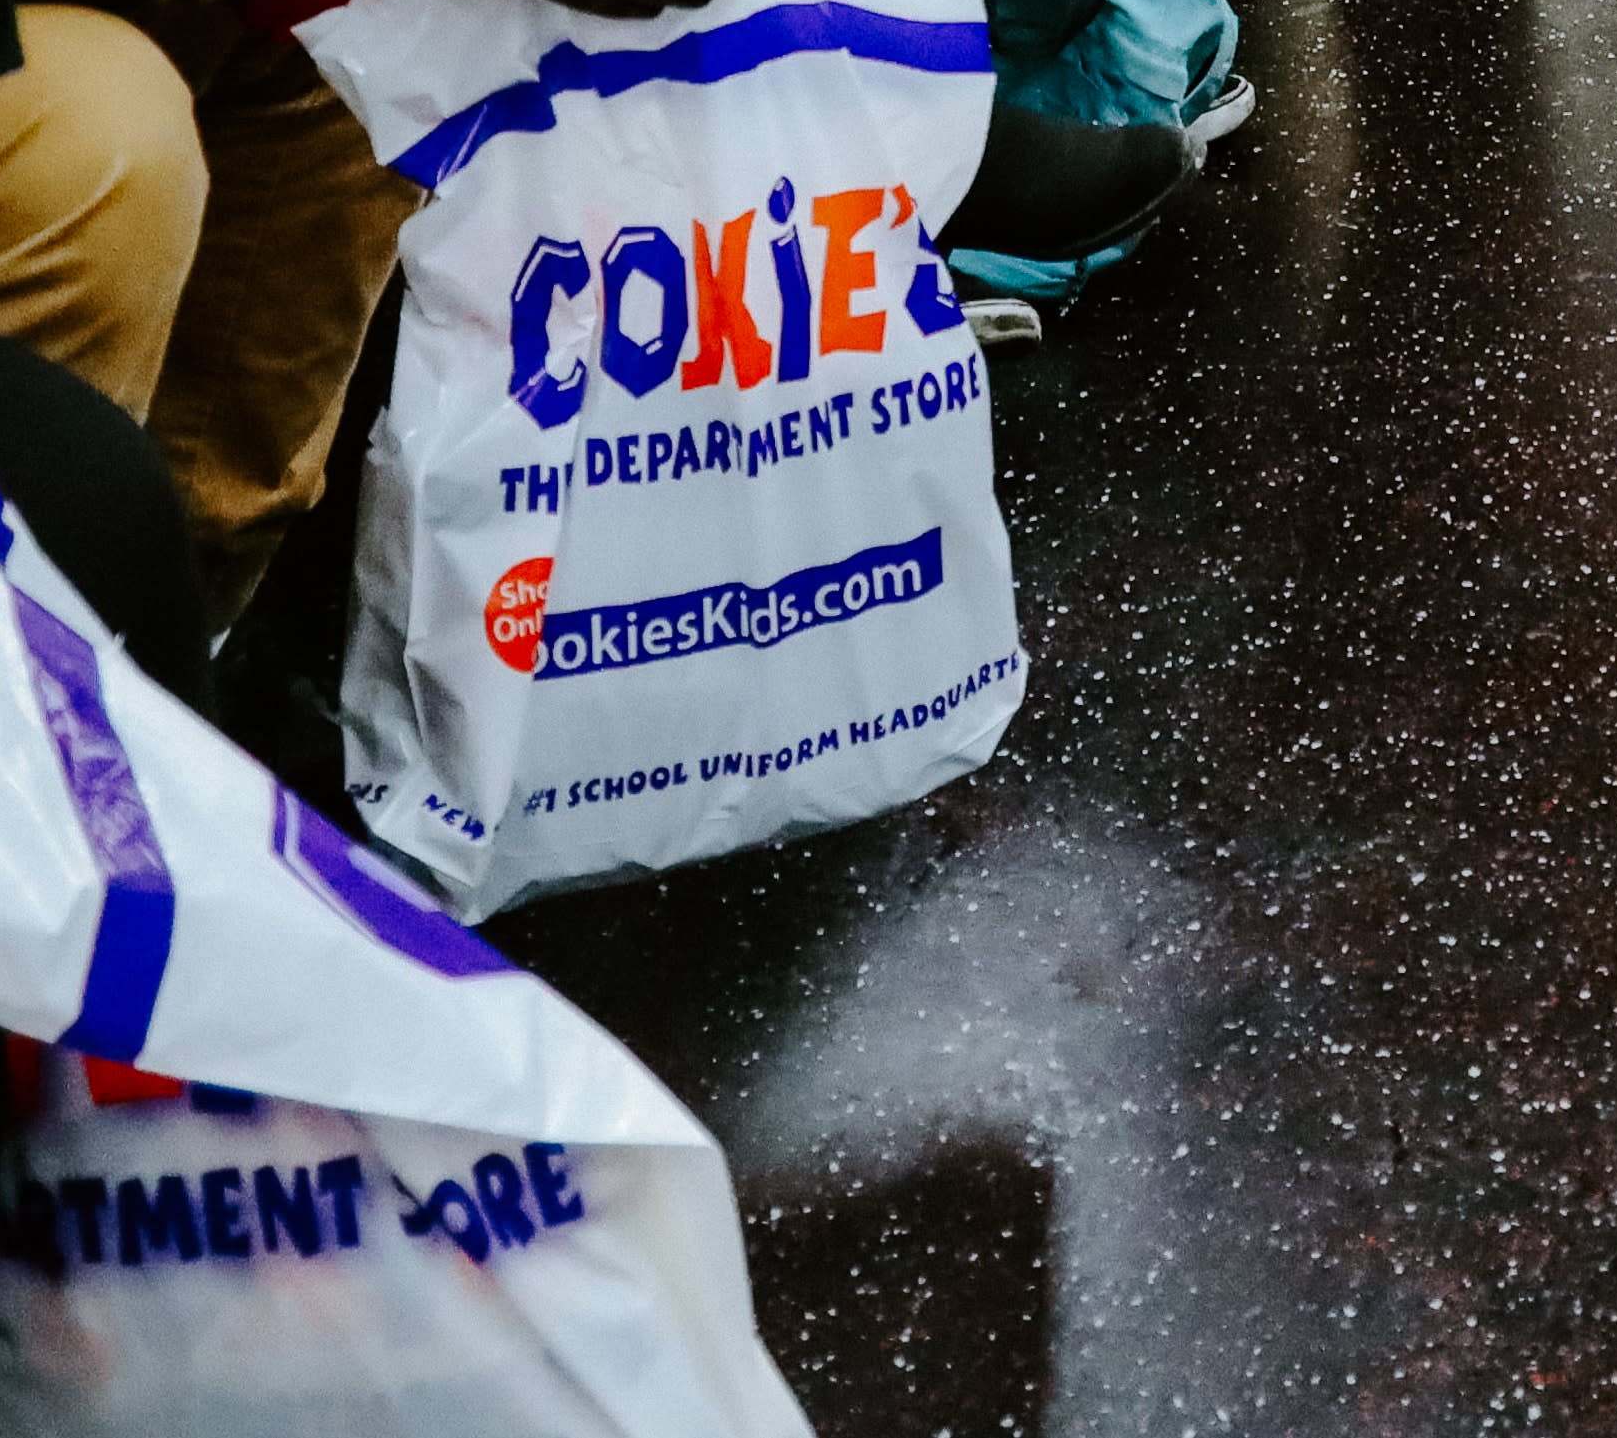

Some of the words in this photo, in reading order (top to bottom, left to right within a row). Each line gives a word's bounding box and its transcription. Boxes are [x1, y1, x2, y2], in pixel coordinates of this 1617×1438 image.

[499, 463, 573, 515] TH
[870, 353, 980, 435] STORE
[567, 759, 689, 810] SCHOOL
[699, 725, 840, 784] UNIFORM
